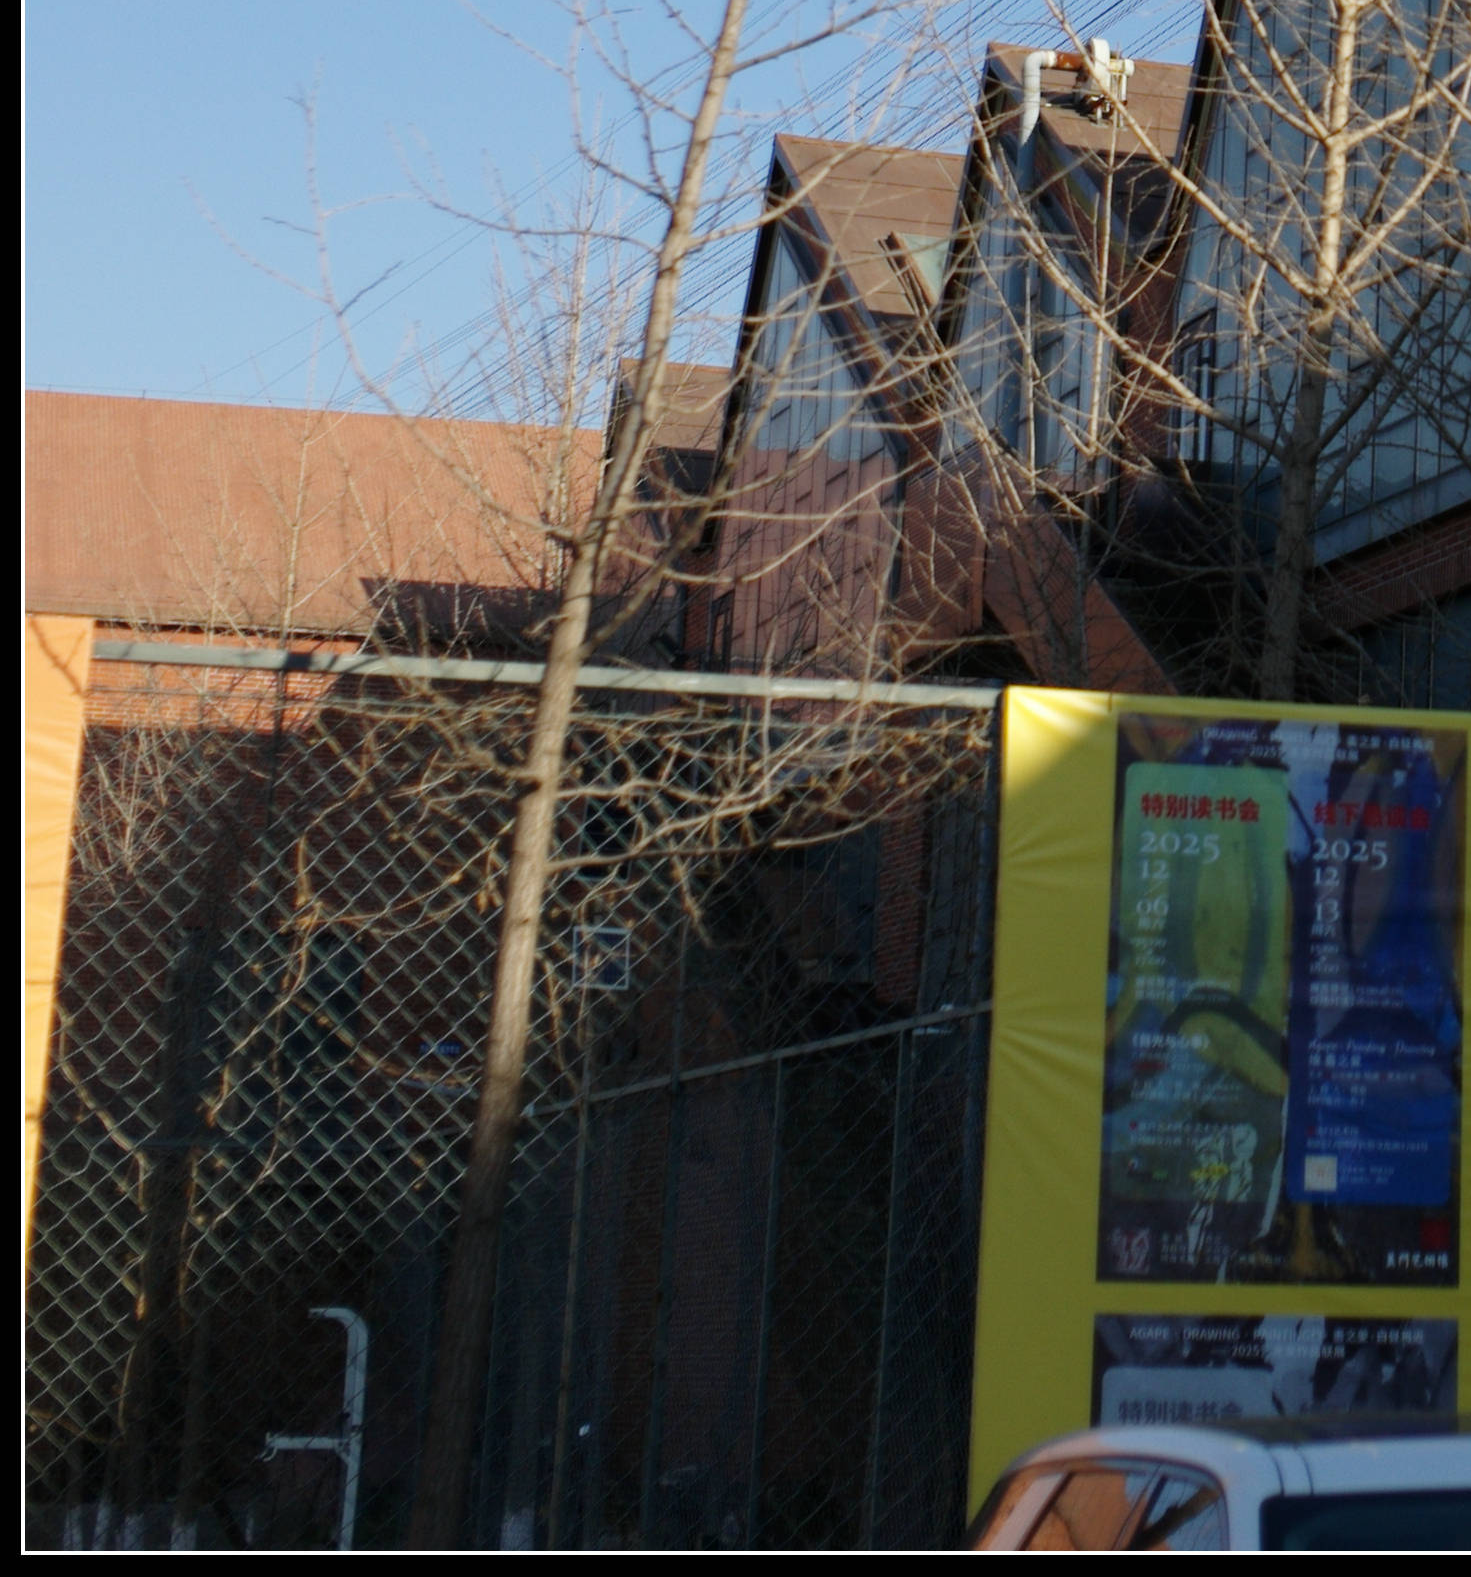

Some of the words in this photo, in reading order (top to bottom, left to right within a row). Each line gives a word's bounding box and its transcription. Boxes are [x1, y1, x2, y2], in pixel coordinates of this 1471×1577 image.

[1140, 792, 1260, 823] 特别读书会
[1139, 830, 1221, 864] 2025
[1312, 837, 1388, 870] 2025
[1140, 858, 1169, 879] 12
[1313, 866, 1340, 886] 12
[1135, 893, 1169, 916] 06
[1314, 897, 1340, 923] 13
